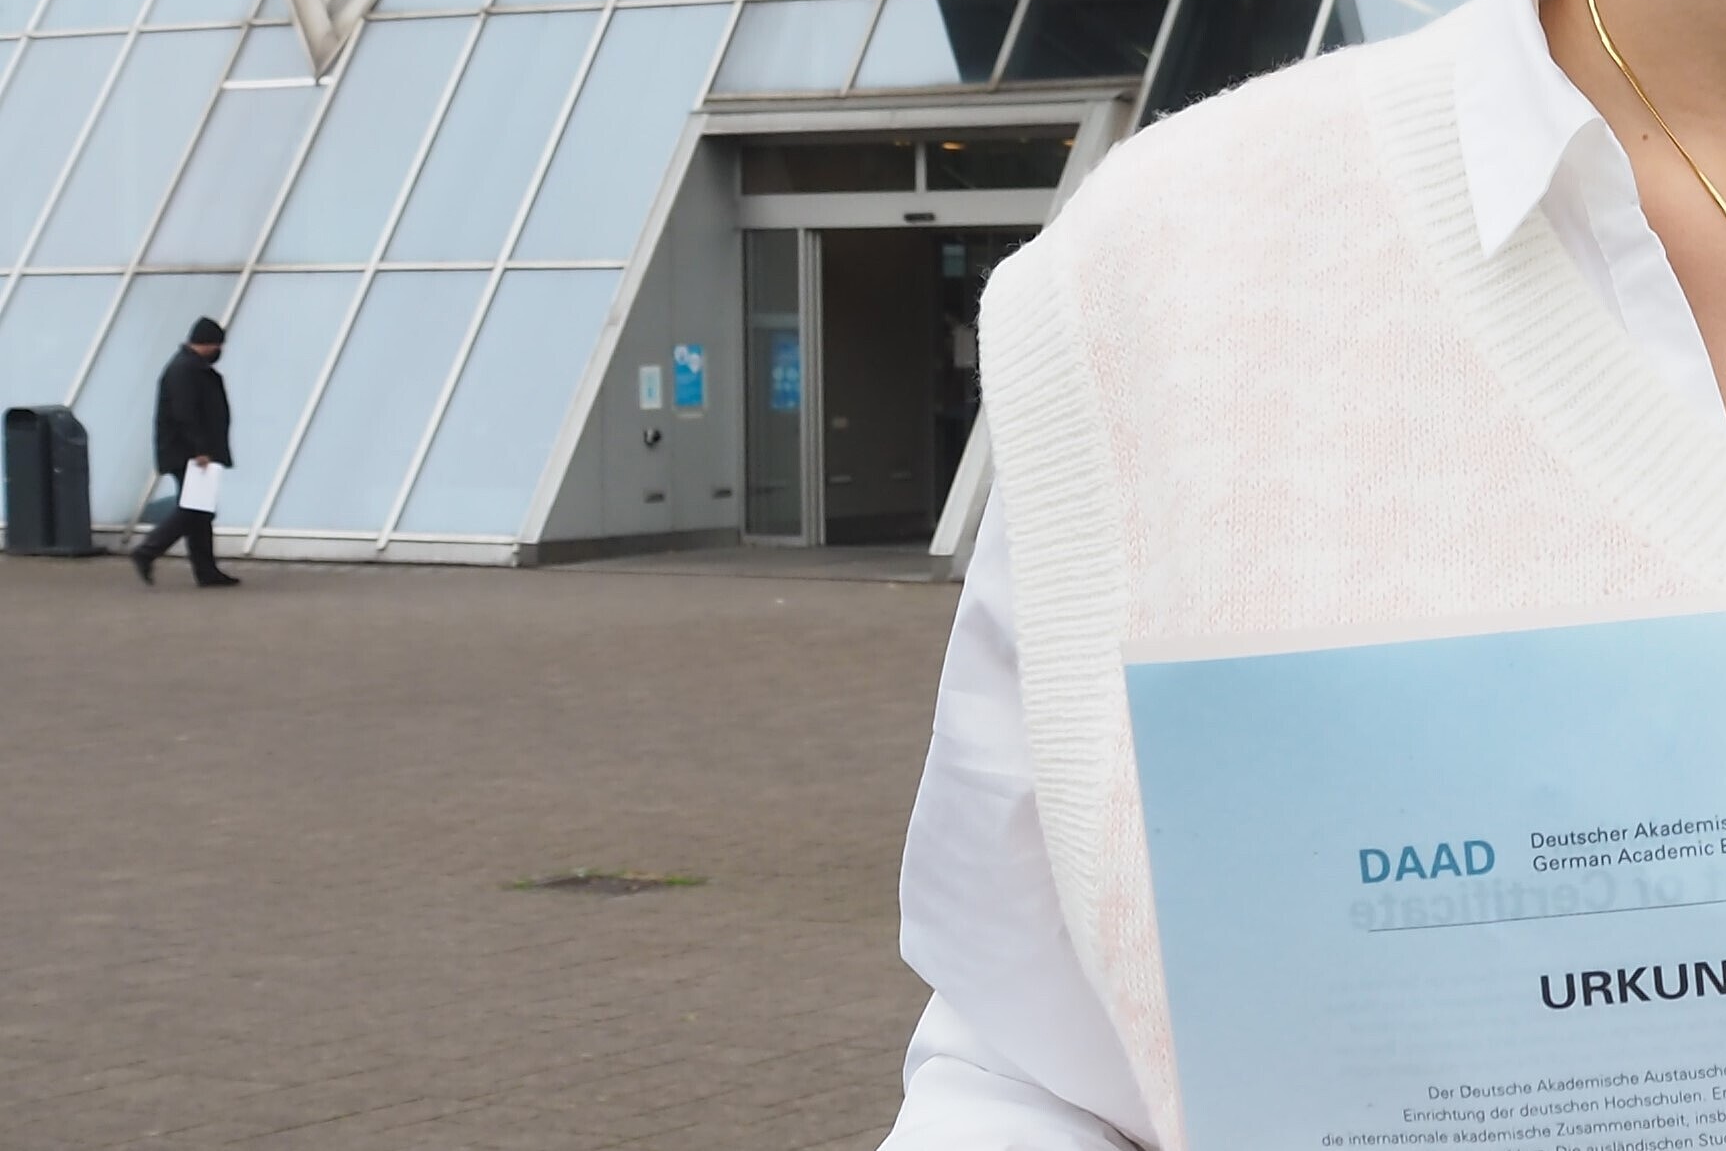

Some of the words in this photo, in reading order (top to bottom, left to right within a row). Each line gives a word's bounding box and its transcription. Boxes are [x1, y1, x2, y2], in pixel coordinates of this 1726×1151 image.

[1531, 827, 1628, 849] Deutscher
[1359, 840, 1495, 883] DAAD
[1533, 854, 1611, 872] German
[1618, 840, 1714, 864] Academic
[1428, 1086, 1454, 1100] Der
[1460, 1082, 1532, 1099] Deutsche
[1537, 1073, 1639, 1092] Akademische
[1403, 1107, 1485, 1125] Einrichtung
[1490, 1106, 1514, 1119] der
[1520, 1099, 1599, 1117] deutschen
[1712, 1086, 1726, 1100] Er
[1322, 1134, 1343, 1147] die
[1349, 1130, 1448, 1145] internationale
[1453, 1124, 1551, 1141] akademische
[1555, 1115, 1690, 1136] Zusammenarbeit,
